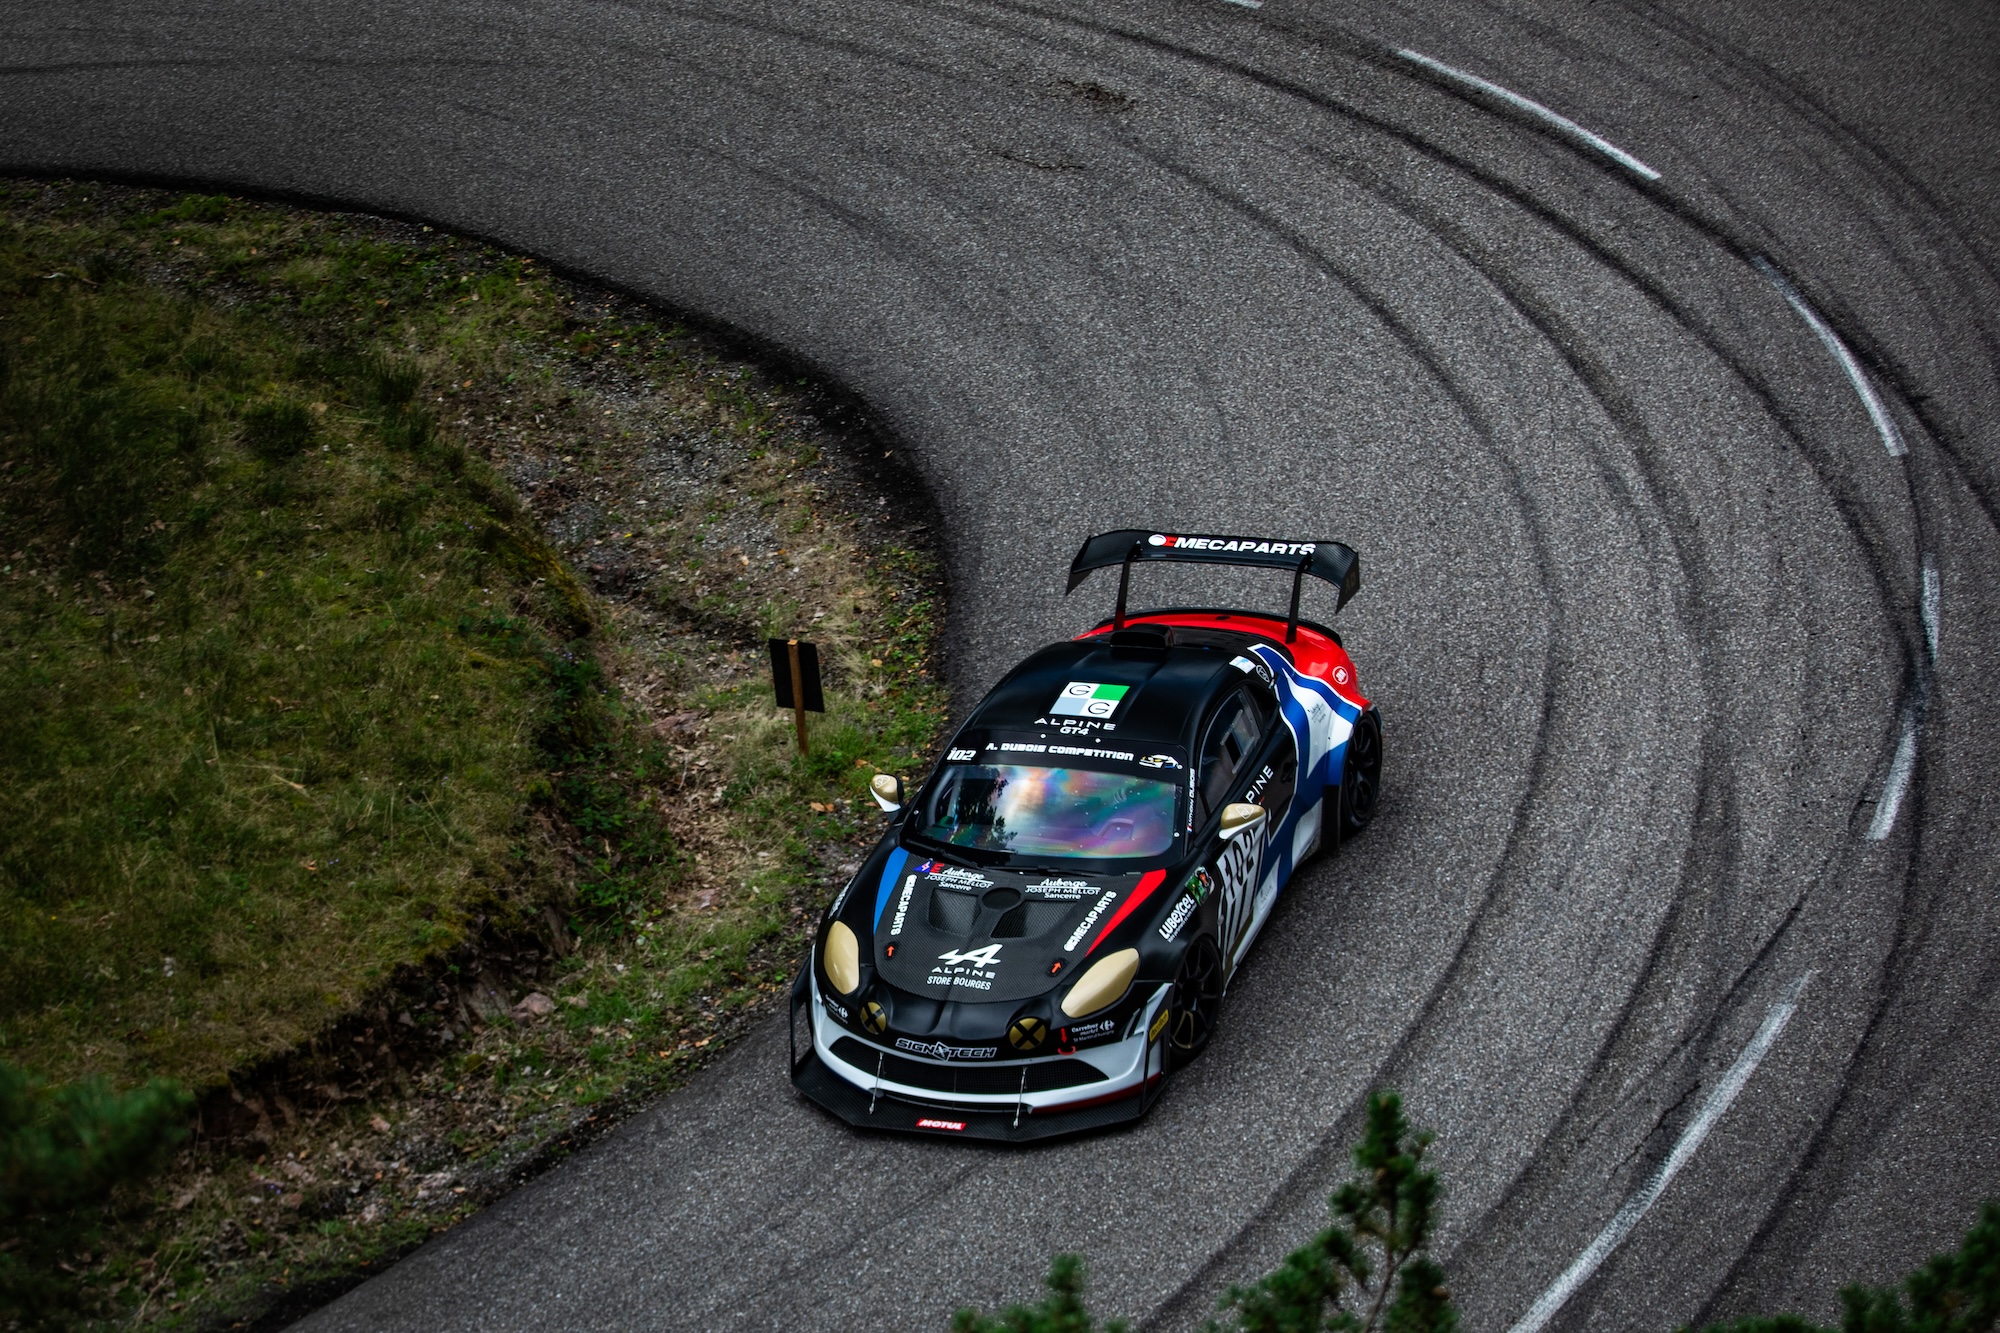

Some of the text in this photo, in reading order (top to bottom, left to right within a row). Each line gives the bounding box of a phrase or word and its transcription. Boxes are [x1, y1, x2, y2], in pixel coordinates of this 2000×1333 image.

[1034, 718, 1116, 731] ALPINE
[1060, 726, 1089, 736] GT4
[1000, 743, 1047, 752] DUBOIS
[1048, 745, 1135, 761] COMPETITION
[942, 867, 985, 881] Auberge
[924, 874, 993, 889] JOSEPH MELLOT
[939, 881, 972, 891] Sancerre
[1040, 878, 1088, 888] Auberge
[1044, 892, 1081, 900] Sancerre
[932, 967, 996, 979] ALPINE
[927, 976, 991, 990] STORE BOURGES
[1071, 1023, 1099, 1033] Carrefour
[919, 1119, 962, 1130] MOTUL
